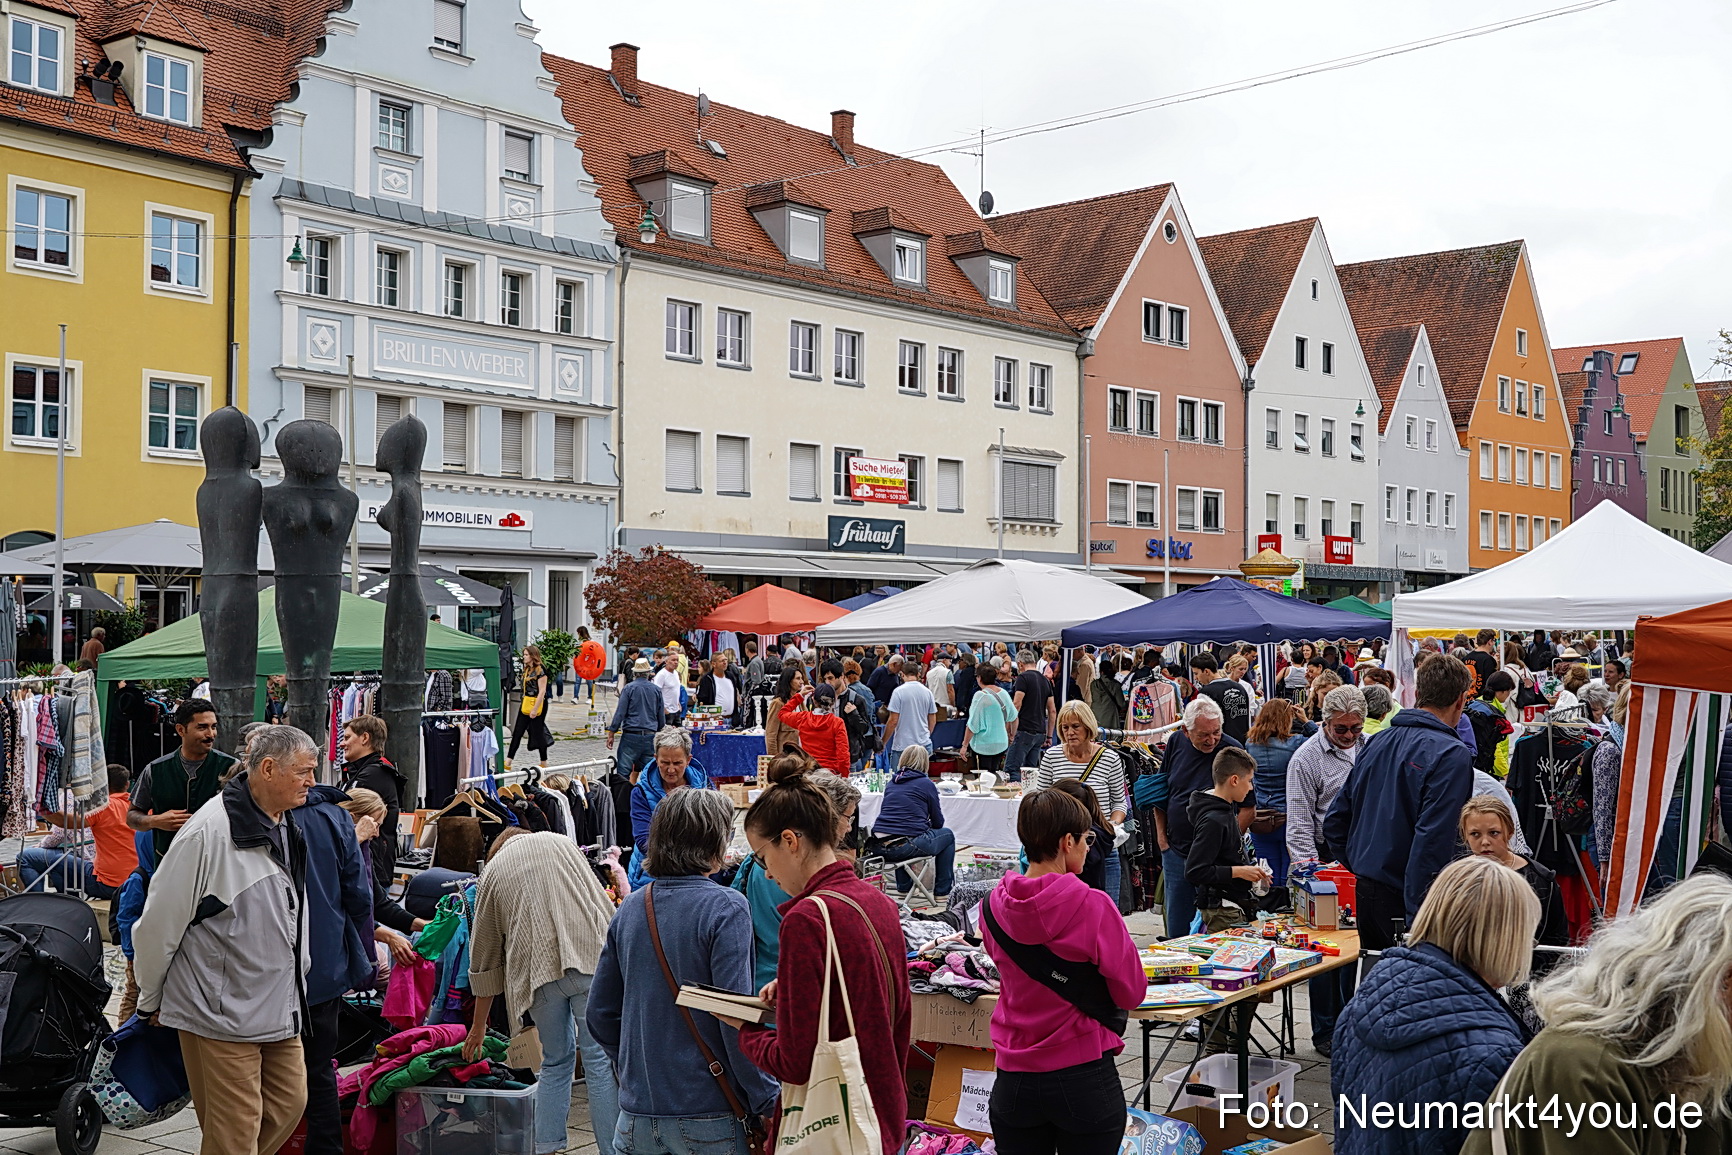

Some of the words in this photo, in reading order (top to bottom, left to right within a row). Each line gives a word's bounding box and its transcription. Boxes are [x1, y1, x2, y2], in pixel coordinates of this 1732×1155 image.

[382, 338, 457, 369] BRILLEN
[460, 349, 526, 378] WEBER
[852, 461, 878, 473] Suche
[422, 509, 493, 526] IMMOBILIEN
[832, 519, 904, 551] frühauf
[1332, 540, 1353, 555] WITT
[929, 1002, 967, 1017] Mädchen
[951, 1022, 963, 1037] je
